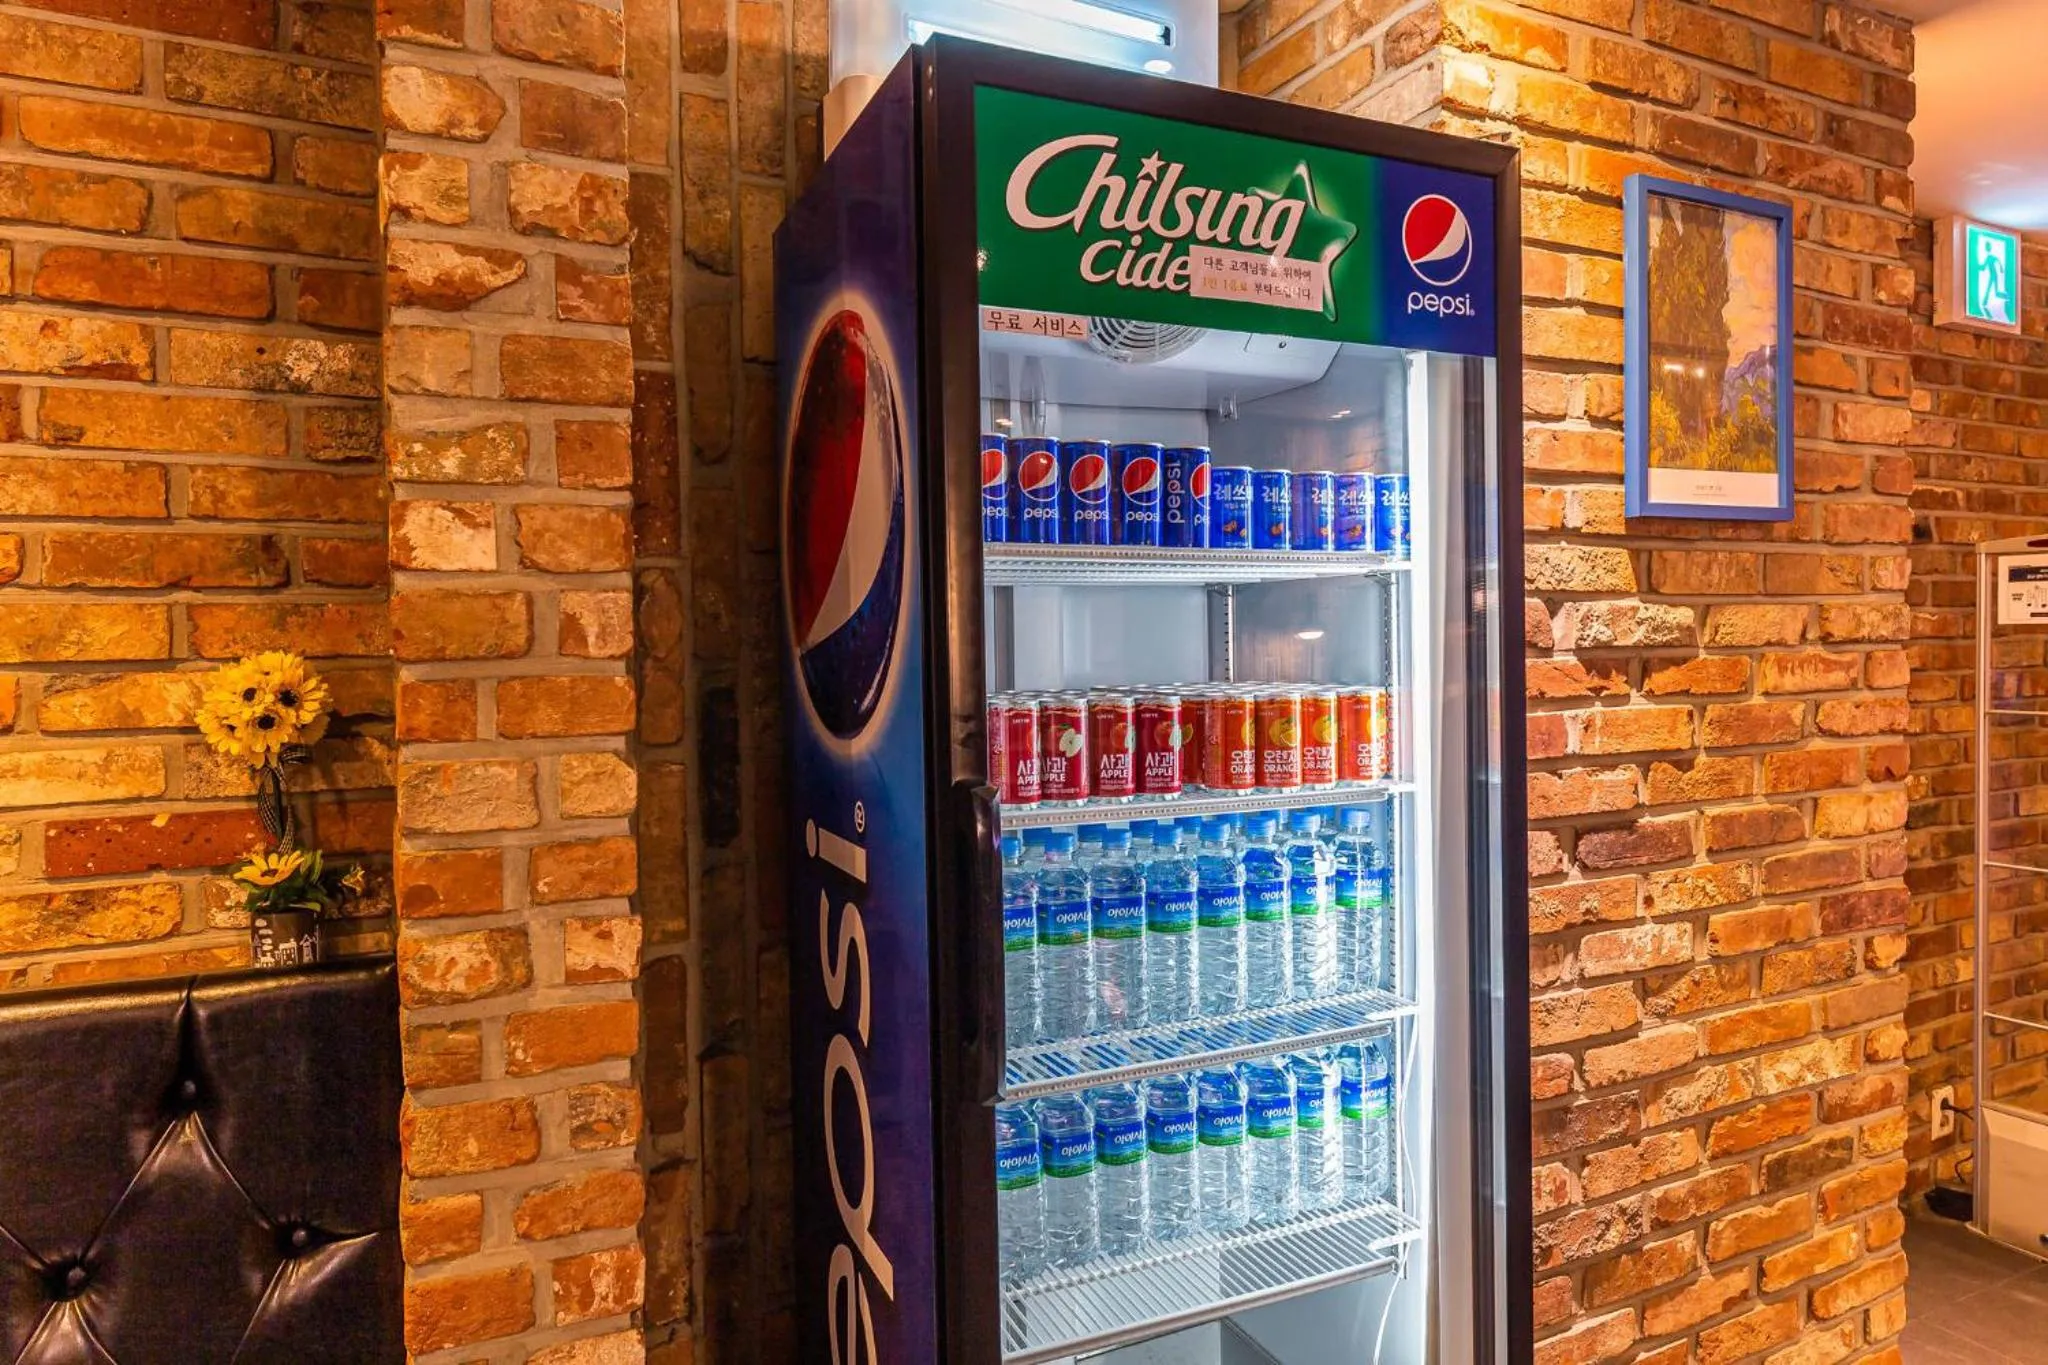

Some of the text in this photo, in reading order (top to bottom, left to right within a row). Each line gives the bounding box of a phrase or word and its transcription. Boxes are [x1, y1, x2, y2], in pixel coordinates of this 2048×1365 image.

[1005, 134, 1306, 258] Chilsung
[1079, 234, 1190, 291] Cide
[1203, 256, 1224, 271] 다른
[1283, 266, 1312, 282] 위하여
[1407, 291, 1471, 318] pepsi
[987, 311, 1084, 337] 무료 서비스
[1166, 461, 1186, 524] pepsi
[1023, 506, 1057, 520] peps
[1074, 509, 1109, 522] peps
[1125, 511, 1160, 523] peps
[1145, 752, 1174, 768] 사과
[1231, 750, 1255, 764] 오렌
[1100, 768, 1129, 778] APPLE
[1145, 767, 1174, 777] APPLE
[1230, 764, 1255, 775] ORAN
[806, 817, 894, 1365] epsi
